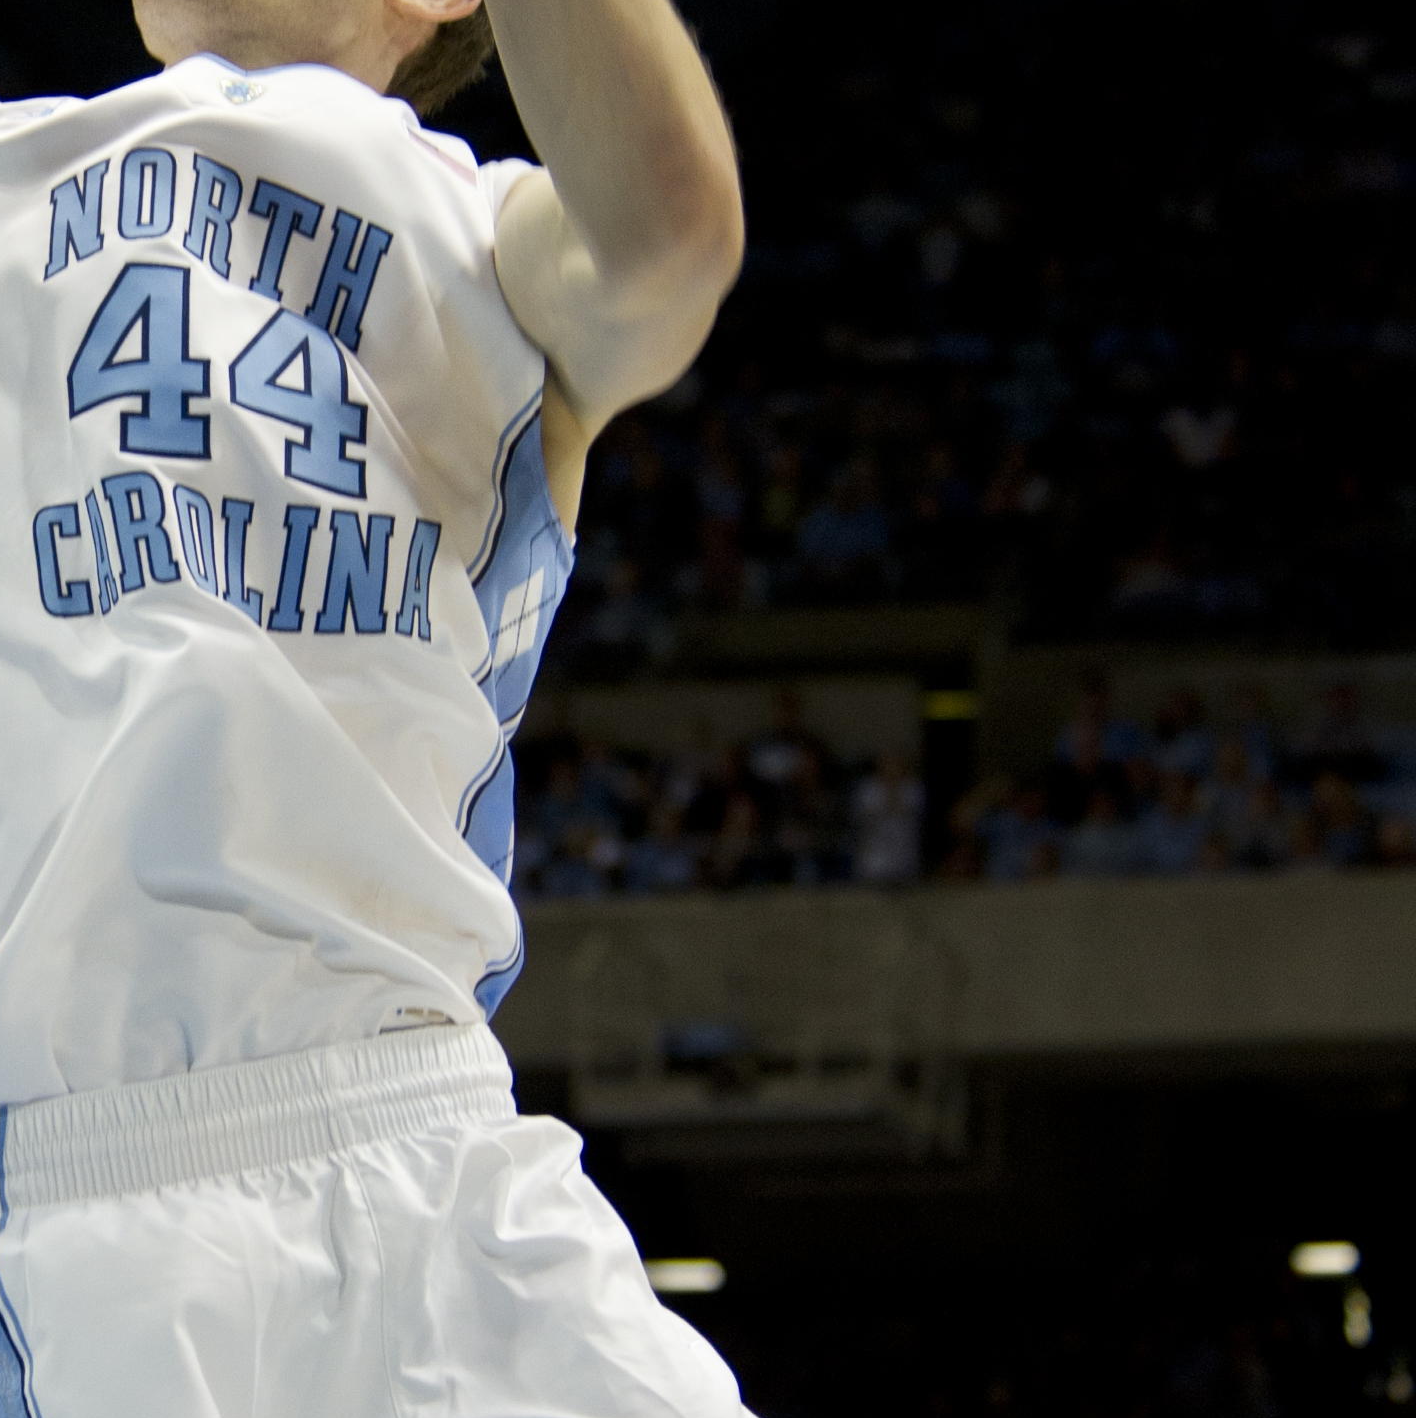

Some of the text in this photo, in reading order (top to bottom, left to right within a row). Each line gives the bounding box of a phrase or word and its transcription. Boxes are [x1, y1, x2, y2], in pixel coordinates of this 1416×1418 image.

[43, 147, 393, 353] NORTH
[67, 262, 368, 500] 44
[33, 471, 442, 643] CAROLINA
